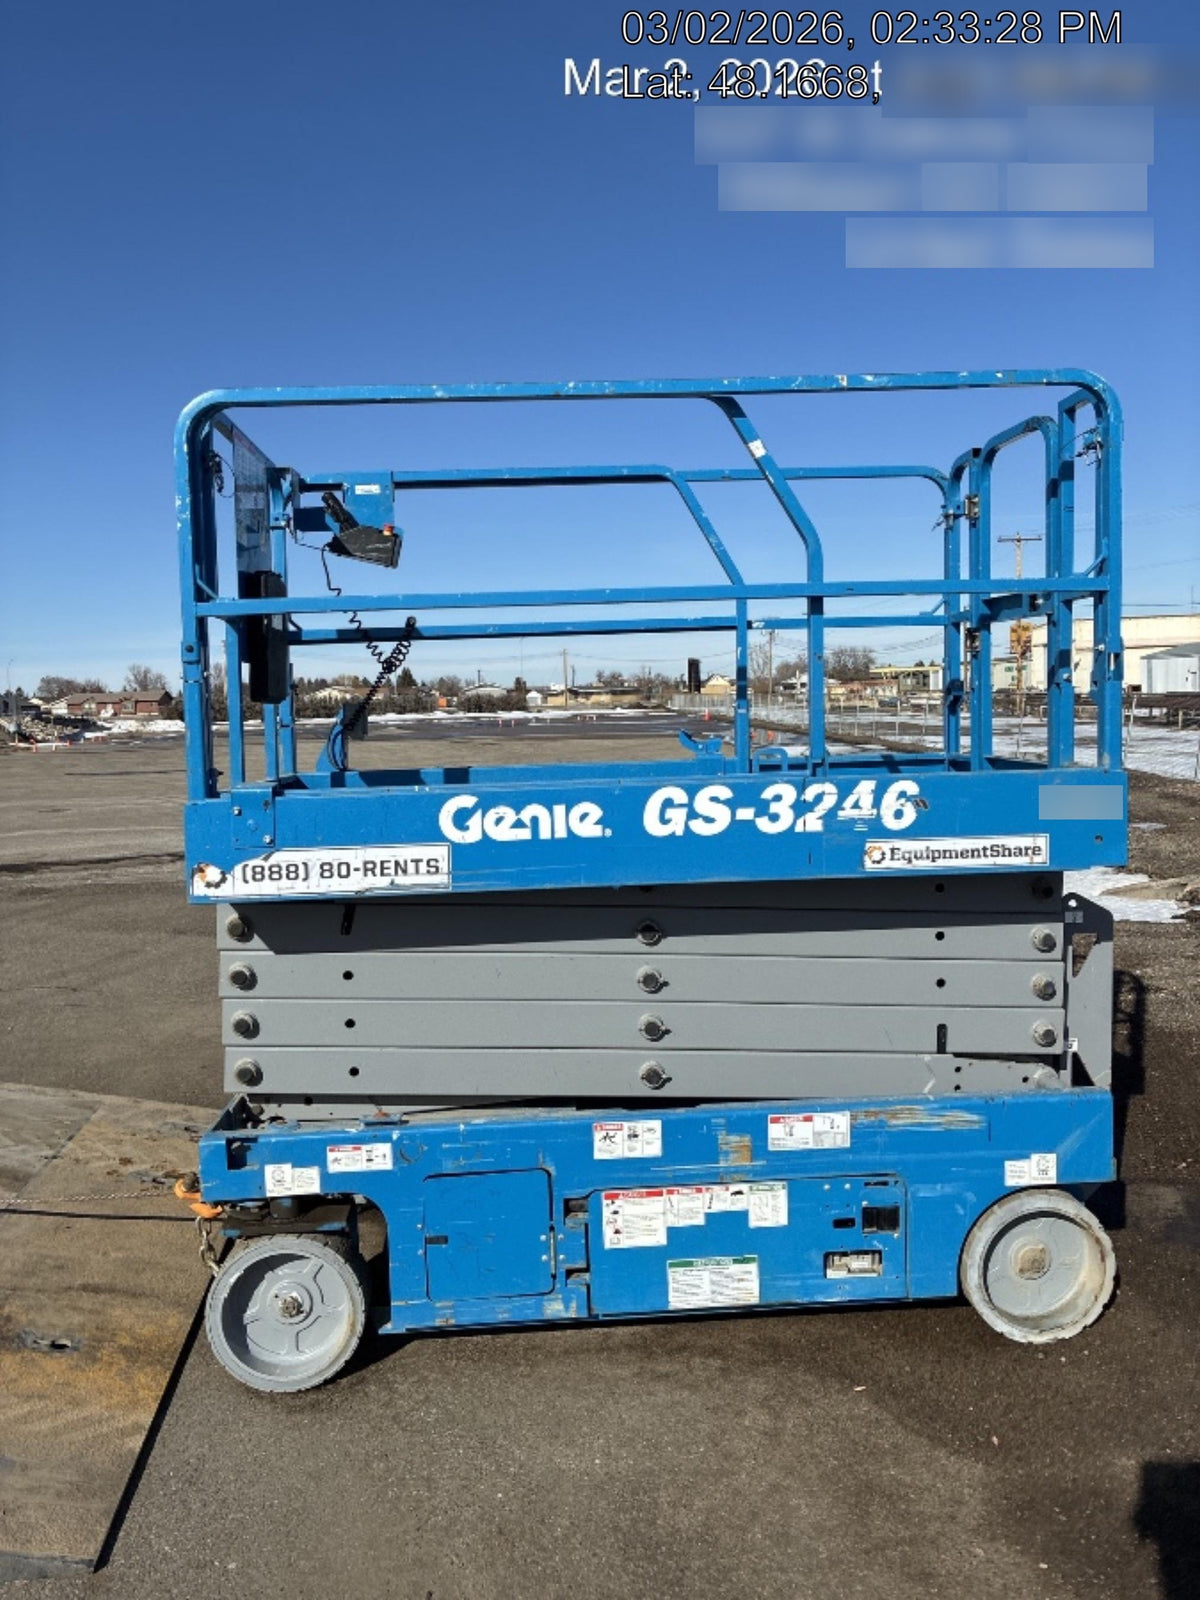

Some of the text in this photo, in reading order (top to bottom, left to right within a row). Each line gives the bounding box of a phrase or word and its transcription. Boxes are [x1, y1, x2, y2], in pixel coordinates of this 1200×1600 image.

[438, 779, 921, 844] Genie GS-3246
[889, 843, 1043, 863] EquipmentShare
[241, 858, 441, 885] (888) 80-RENTS
